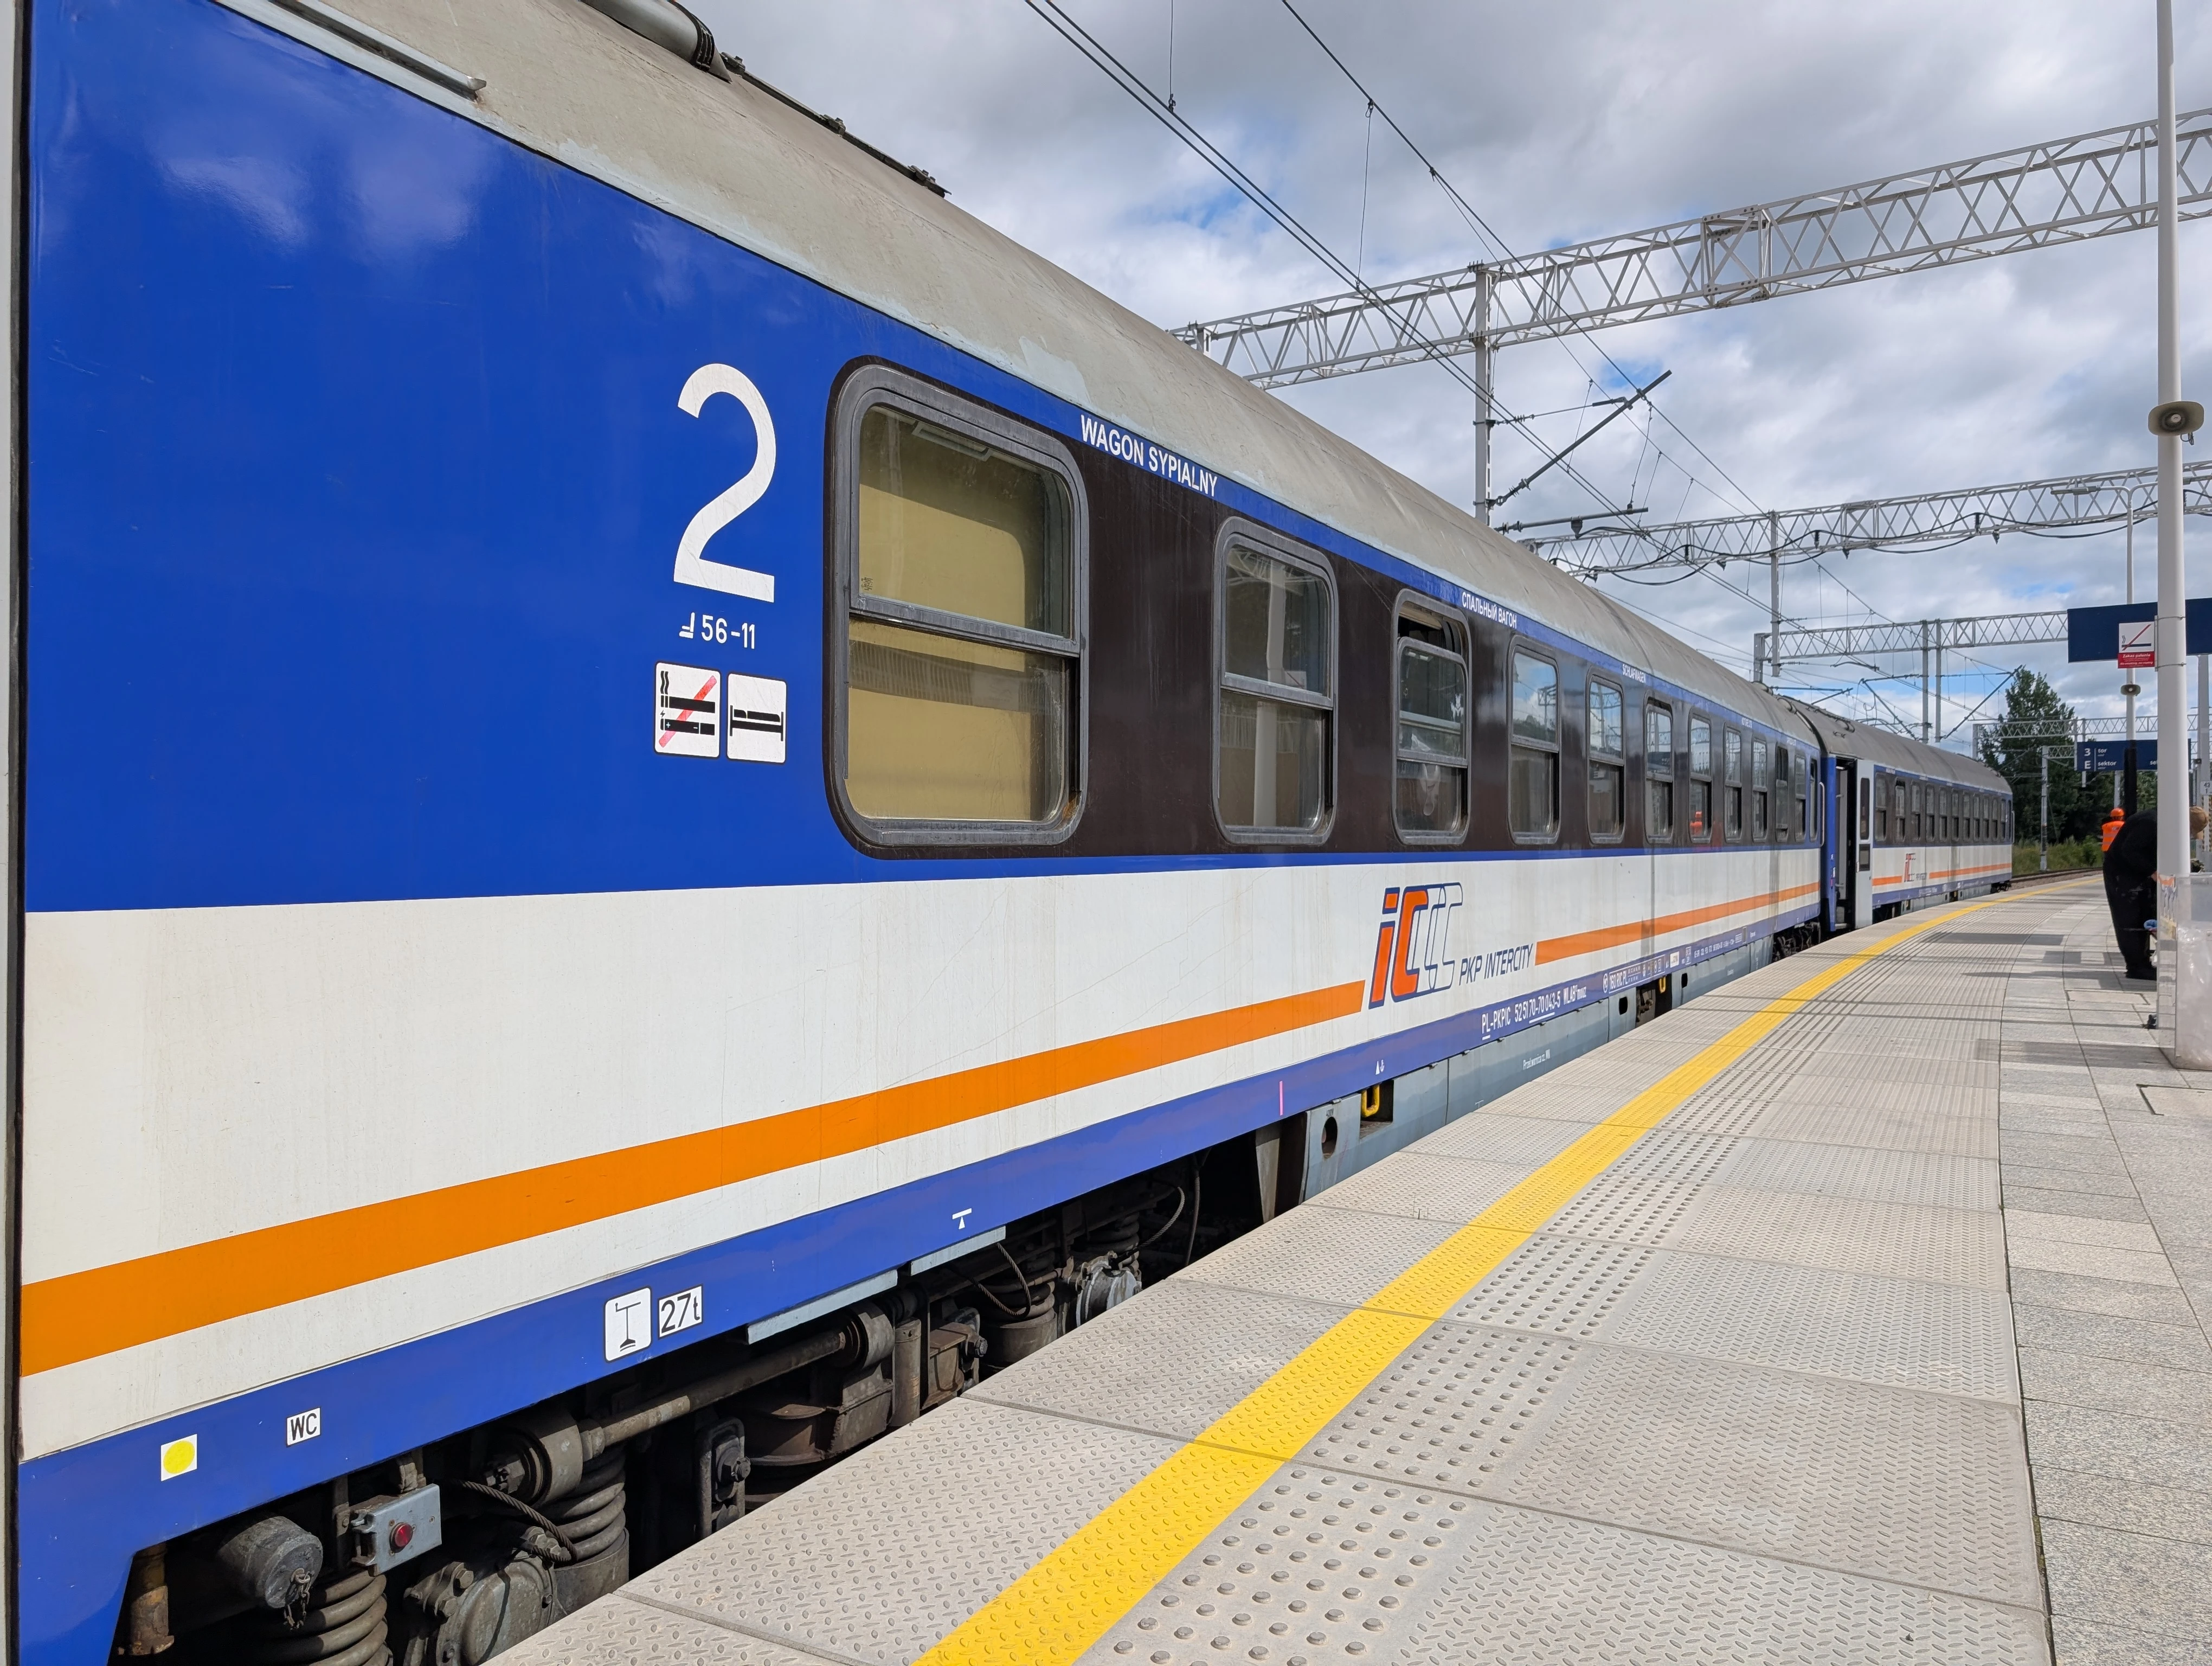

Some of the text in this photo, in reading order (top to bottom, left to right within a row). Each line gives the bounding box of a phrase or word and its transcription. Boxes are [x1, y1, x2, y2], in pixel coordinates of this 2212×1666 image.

[1081, 414, 1218, 497] WAGON SYPIALNY
[673, 363, 776, 603] 2
[1462, 592, 1517, 629] СПАЛЬНЫЙ ВАГОН
[2084, 748, 2091, 757] 3
[2084, 760, 2091, 769] E
[1458, 943, 1534, 986] PKP INTERCITY
[1482, 1006, 1512, 1034] PL-PKPIC
[660, 1292, 700, 1332] 27t
[289, 1415, 318, 1440] WC
